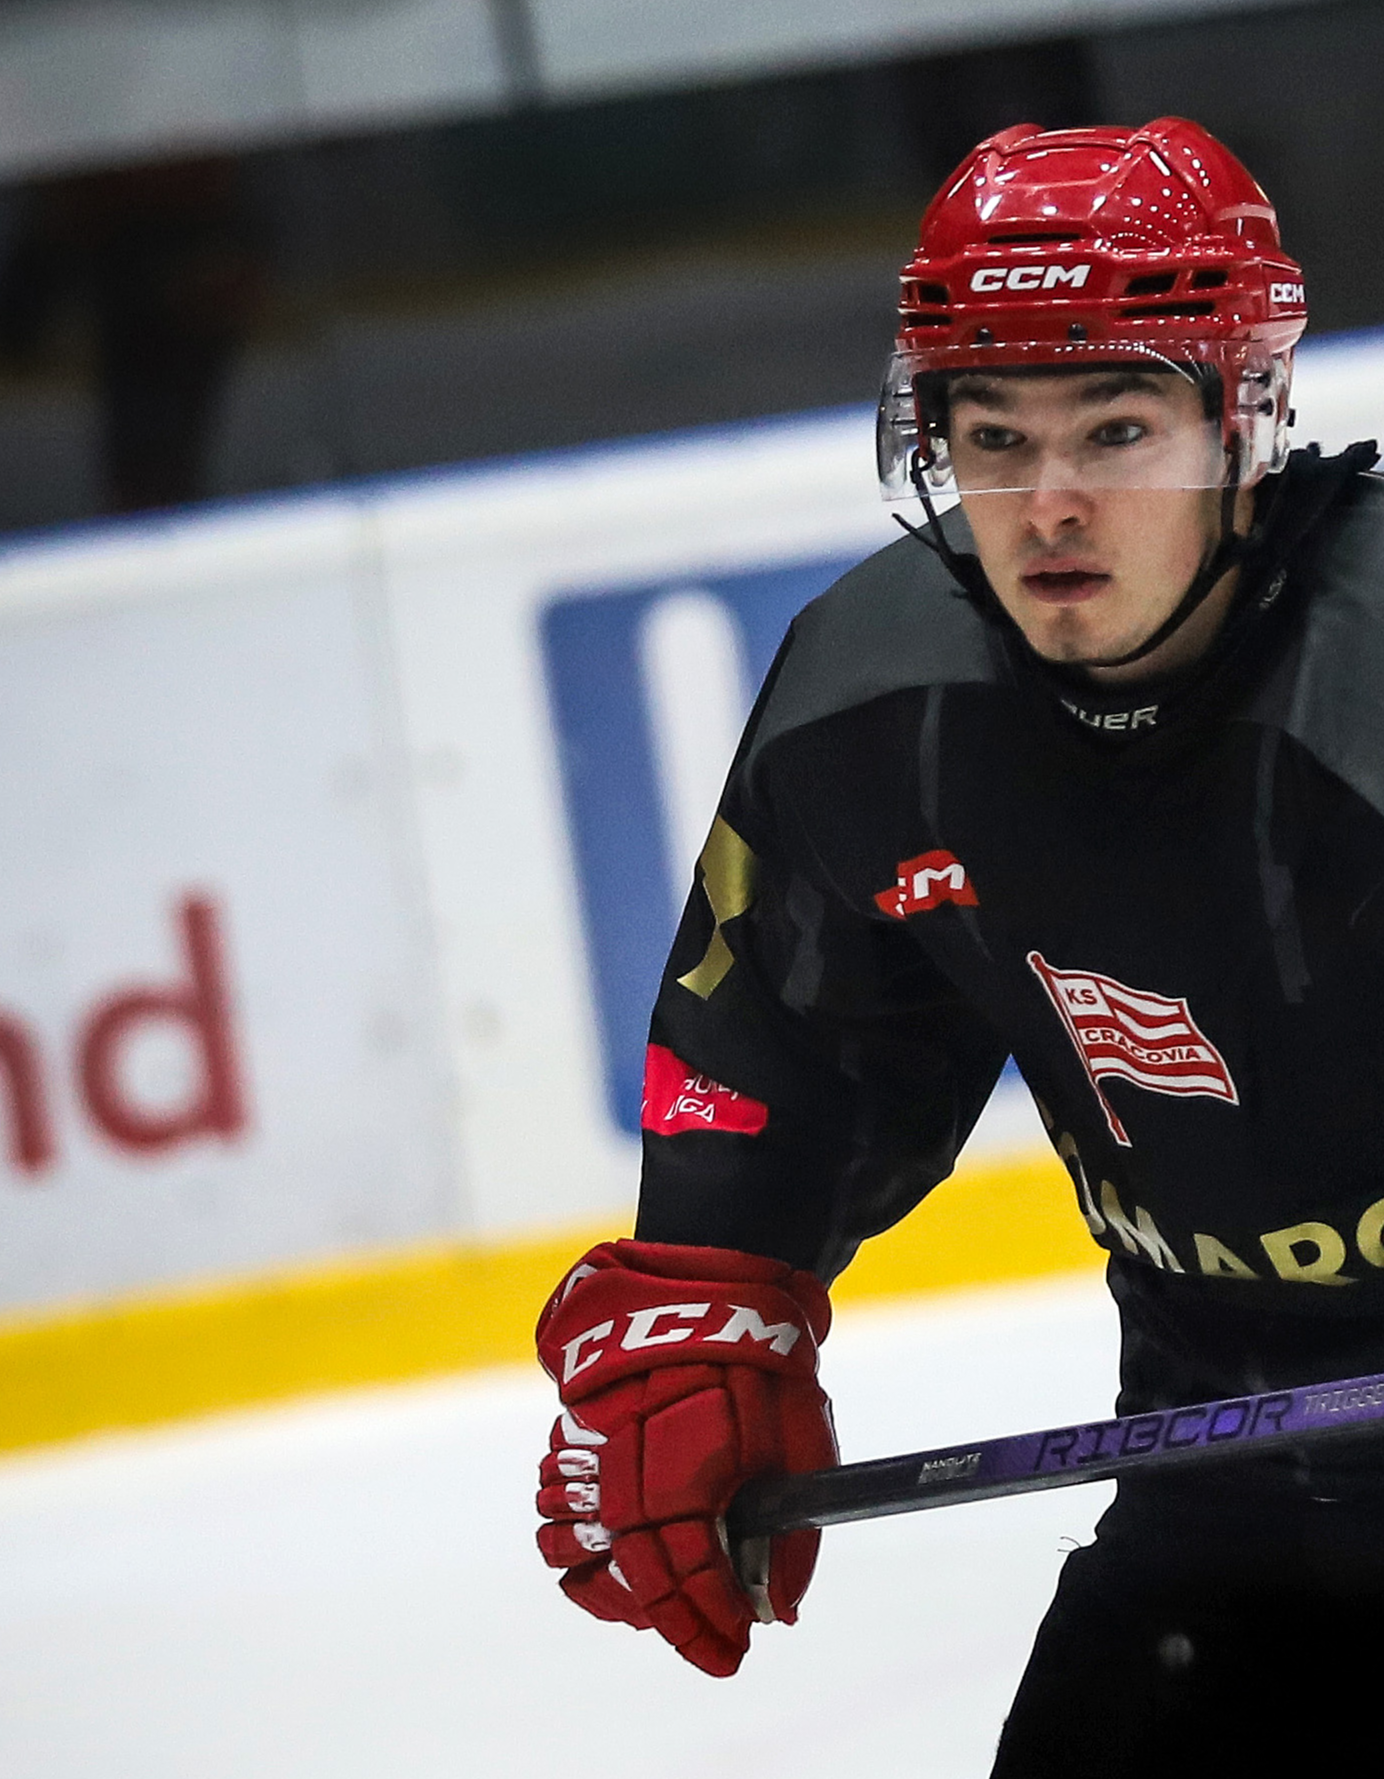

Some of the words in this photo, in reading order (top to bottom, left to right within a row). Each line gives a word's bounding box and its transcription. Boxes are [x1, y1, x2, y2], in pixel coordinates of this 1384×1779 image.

[970, 264, 1091, 292] CCM
[1270, 282, 1305, 303] CCM
[1064, 987, 1098, 1006] KS
[1085, 1029, 1201, 1063] CRACOVIA
[561, 1302, 801, 1385] CCM
[1034, 1391, 1293, 1471] RIBCOR
